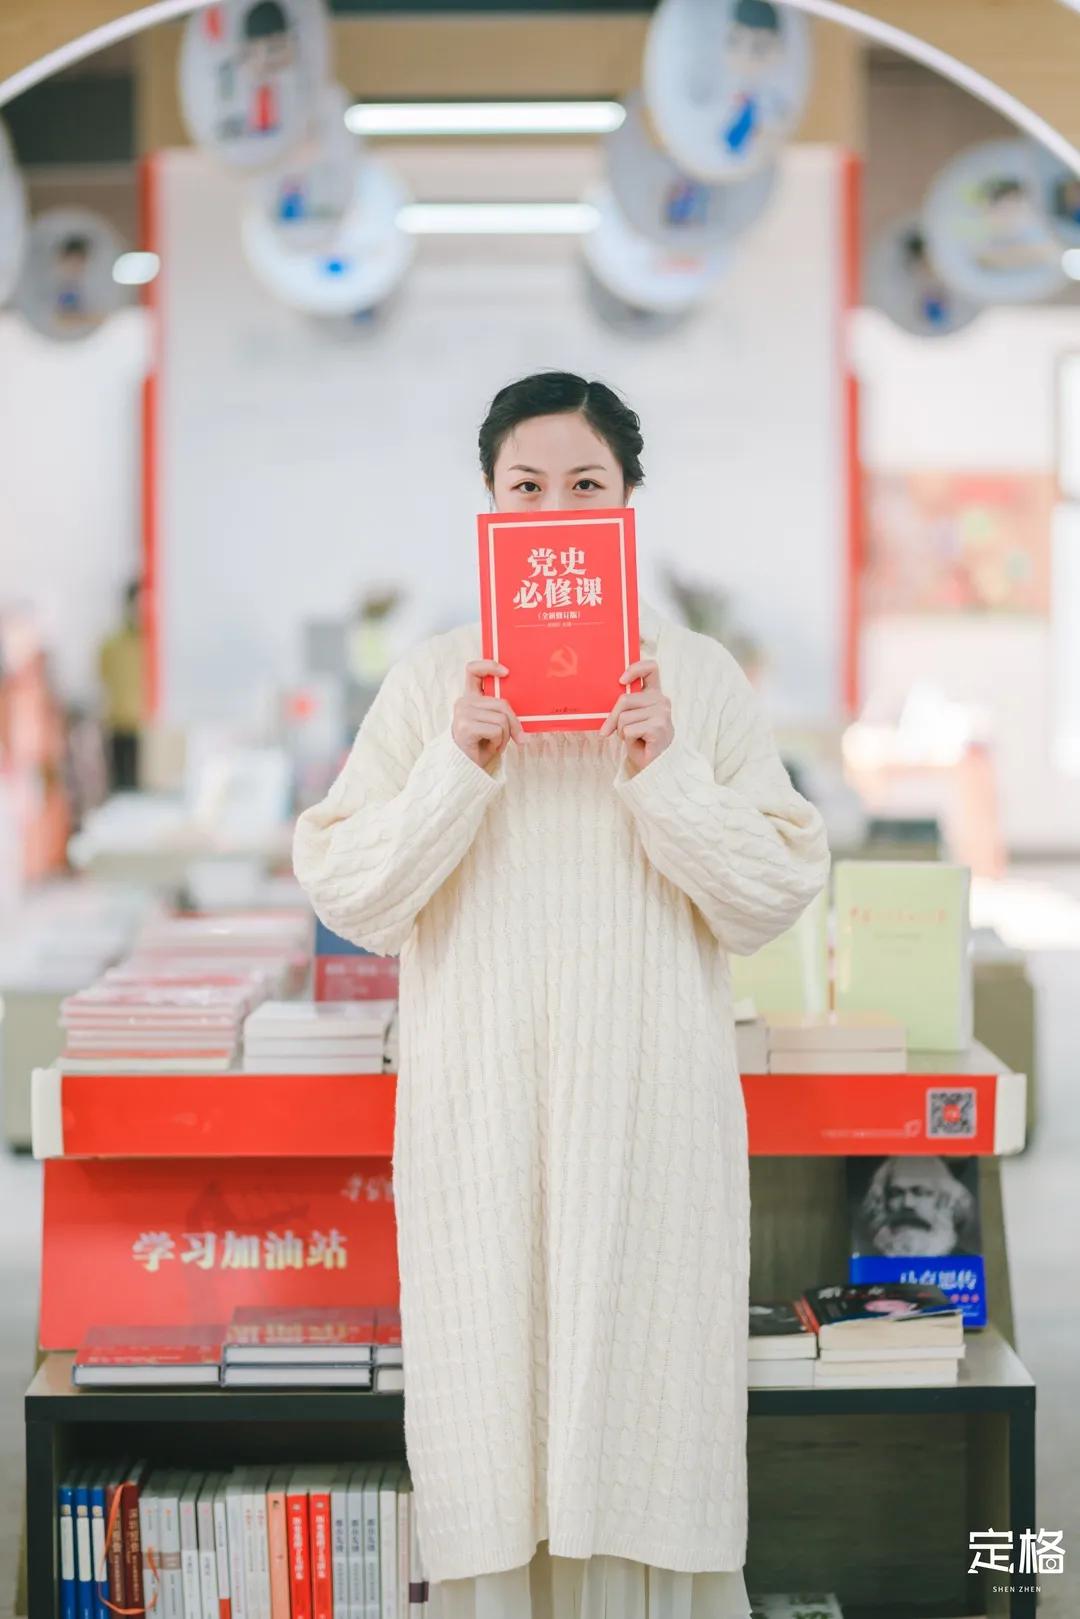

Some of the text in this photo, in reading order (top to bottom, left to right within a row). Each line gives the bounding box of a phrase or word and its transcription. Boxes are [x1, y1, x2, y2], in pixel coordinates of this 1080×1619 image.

[527, 547, 587, 578] 党史
[512, 576, 603, 610] 必修课
[131, 1229, 348, 1272] 学习加油站
